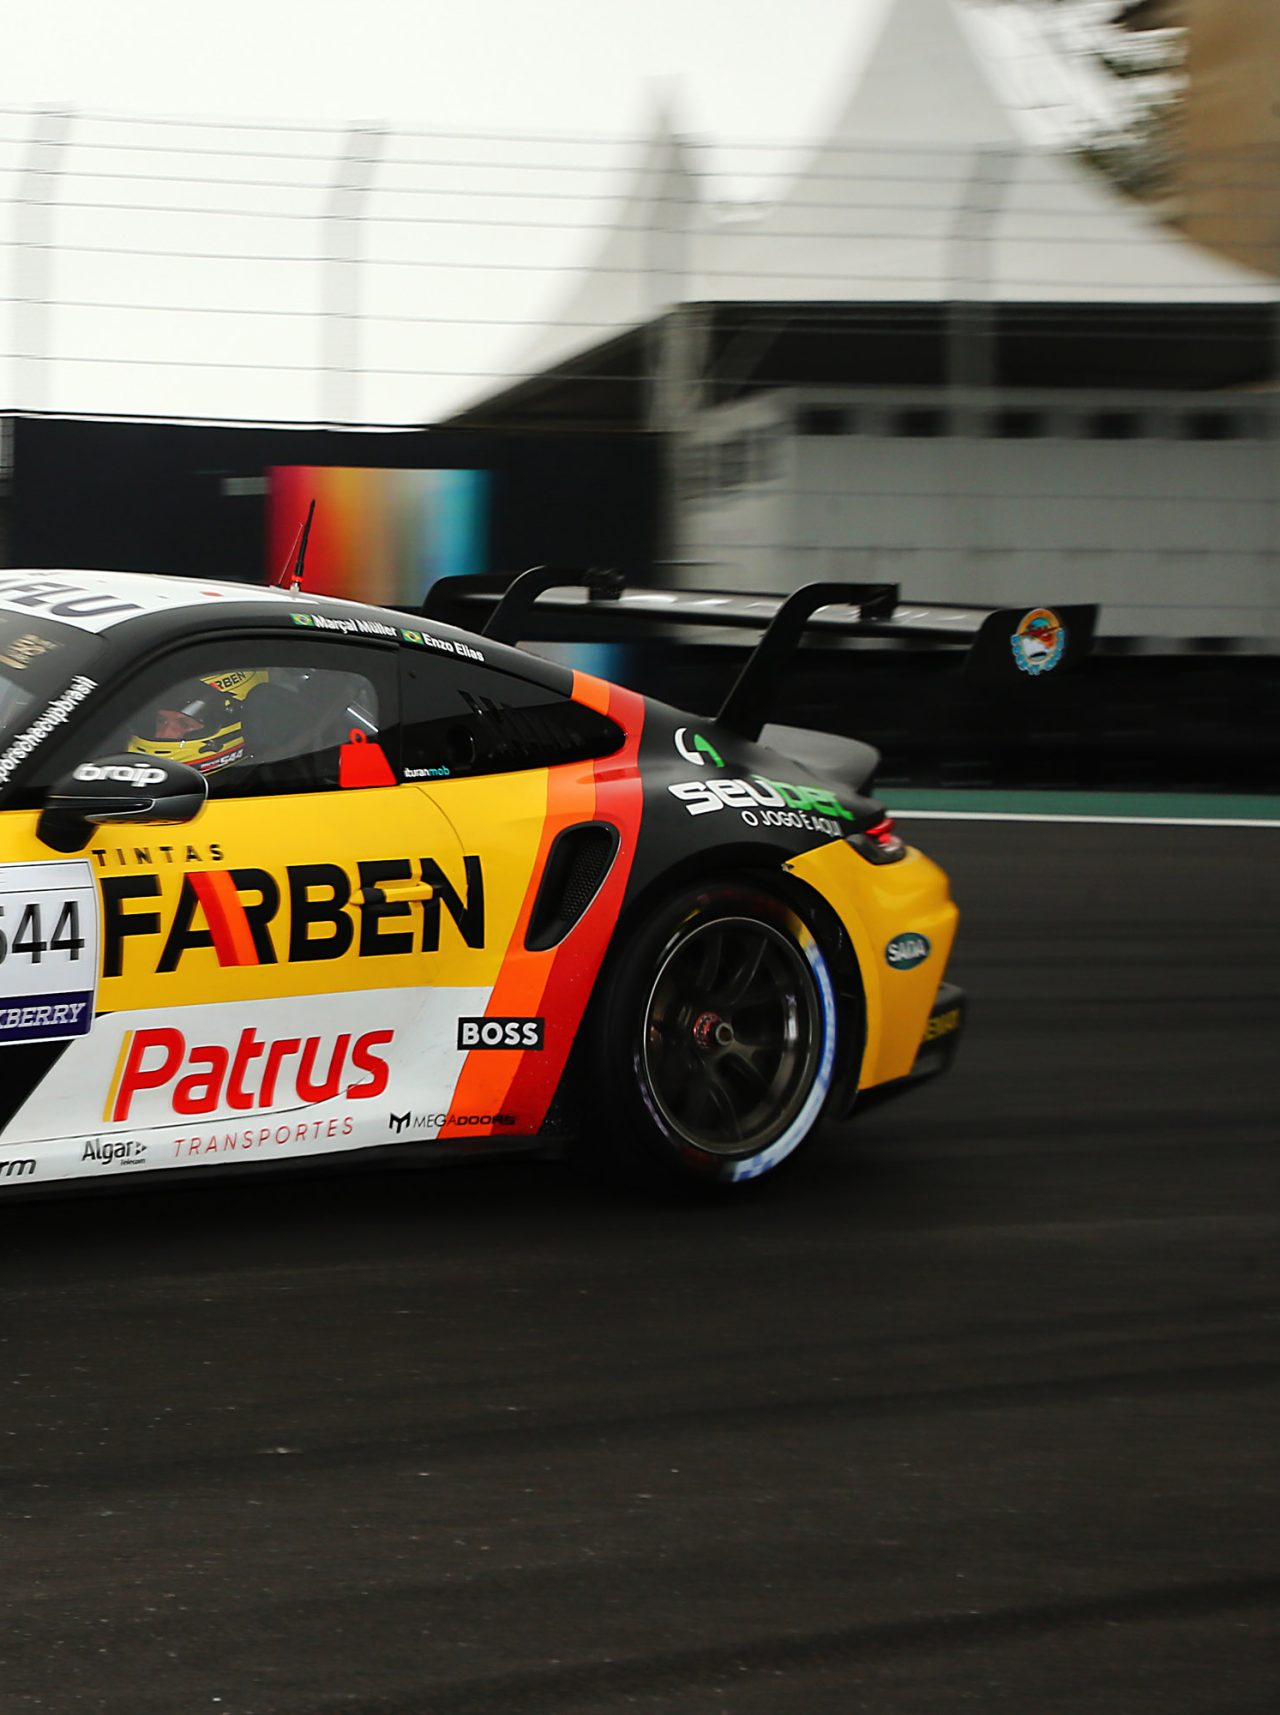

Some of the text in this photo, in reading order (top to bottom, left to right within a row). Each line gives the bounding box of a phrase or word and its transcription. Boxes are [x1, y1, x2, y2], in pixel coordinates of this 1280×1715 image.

[311, 614, 398, 637] Marçal Müller
[422, 632, 485, 662] Enzo Elias
[213, 670, 247, 690] RBEN
[72, 762, 168, 788] braip
[741, 810, 759, 827] O
[760, 810, 803, 829] JOGO
[91, 844, 224, 867] TINTAS
[99, 855, 485, 978] FARBEN
[462, 1022, 538, 1046] BOSS
[113, 1028, 394, 1122] Patrus
[412, 1111, 518, 1129] MEGADOORS
[173, 1115, 356, 1159] TRANSPORTES
[82, 1138, 134, 1165] Algar
